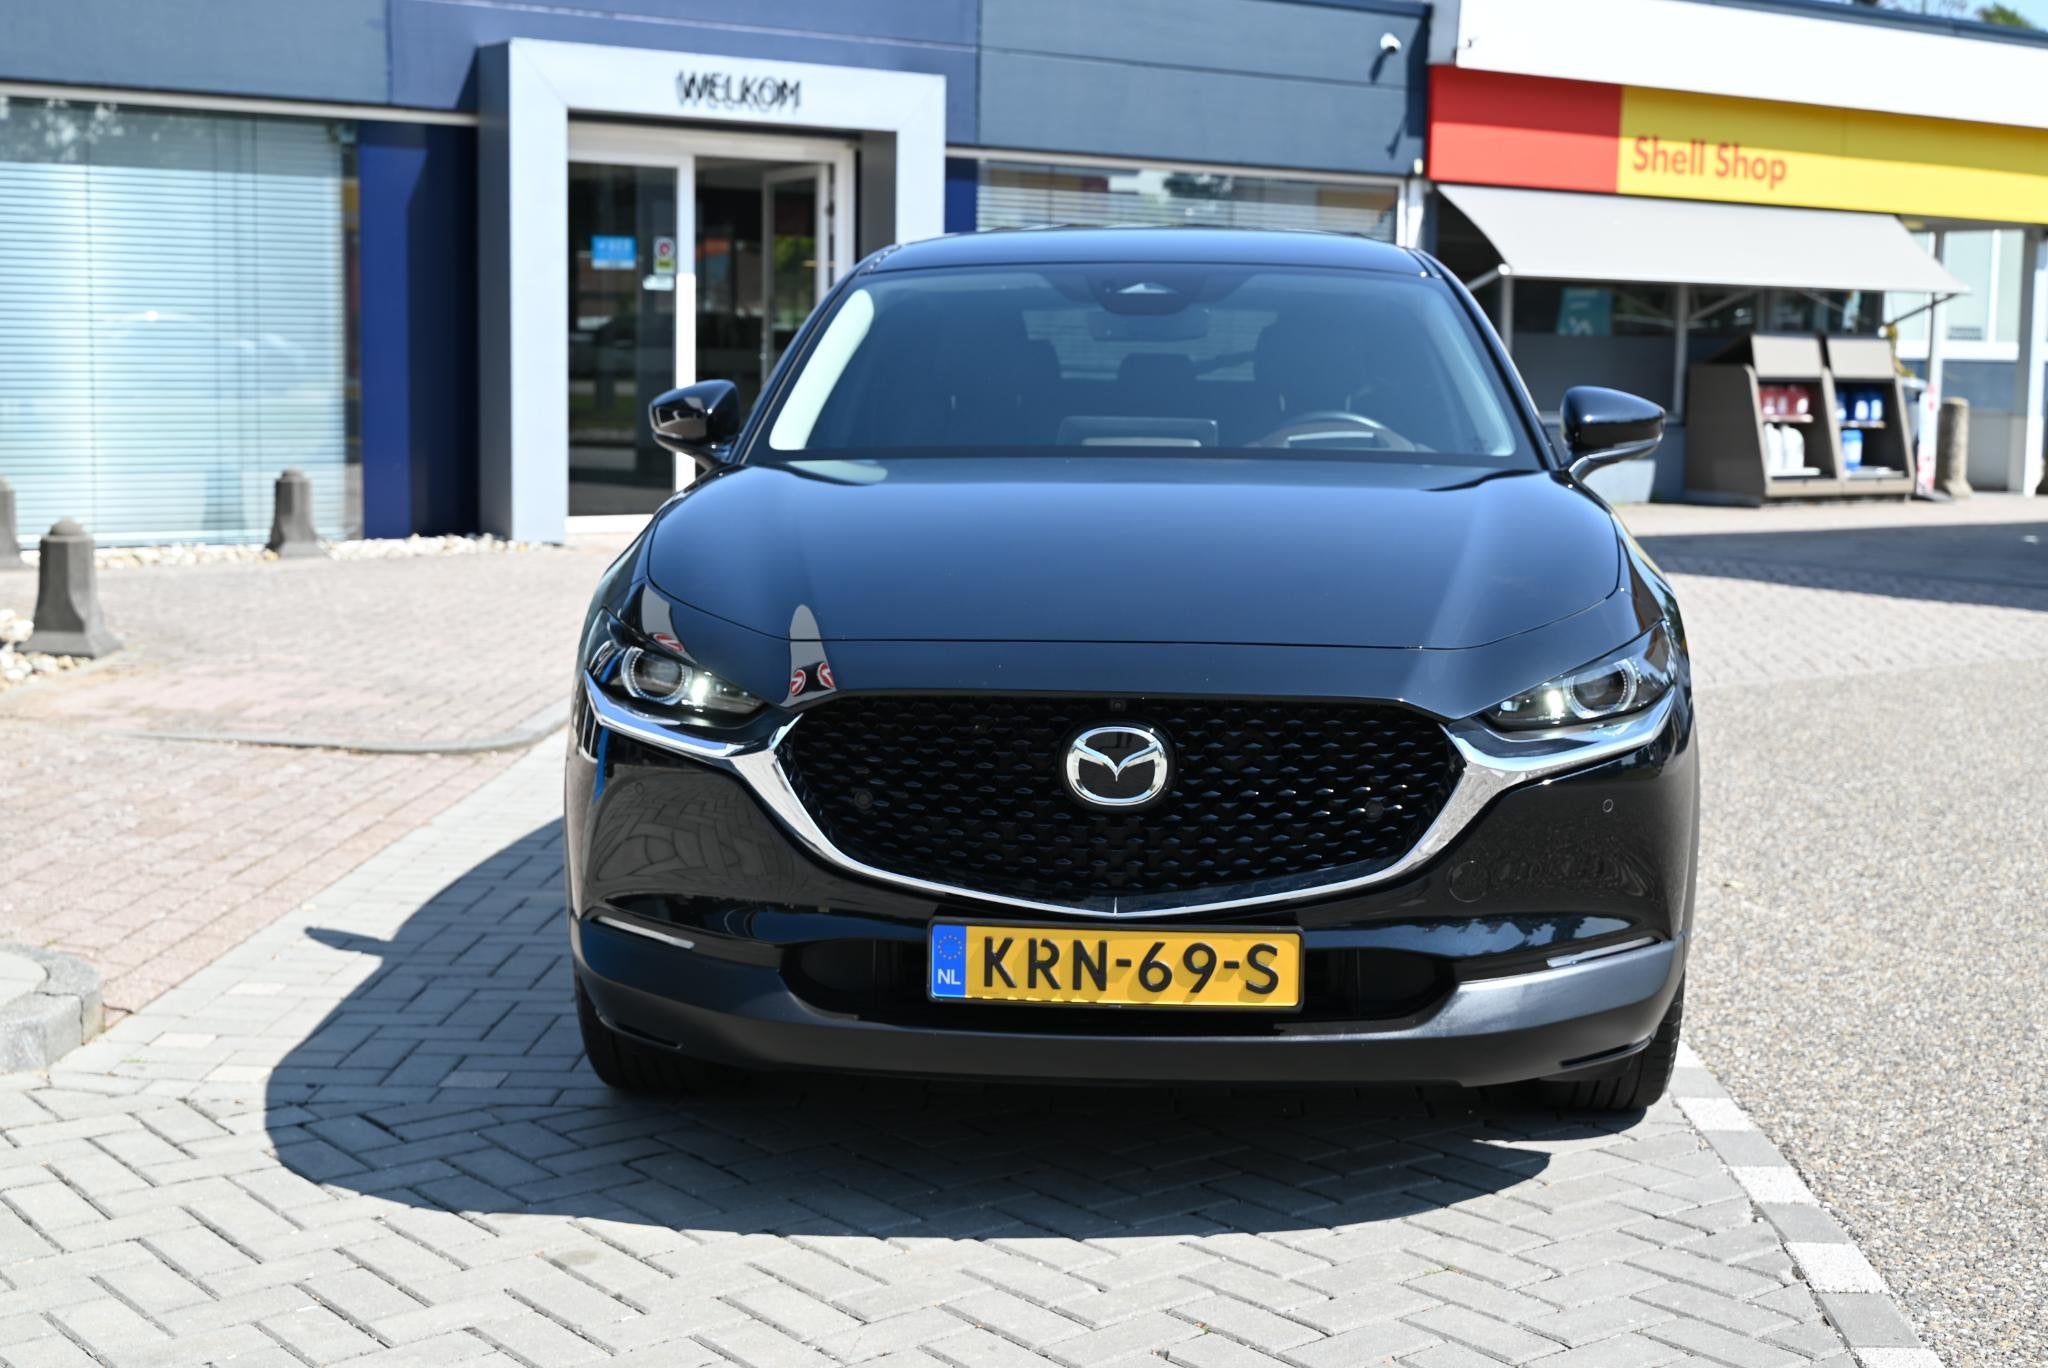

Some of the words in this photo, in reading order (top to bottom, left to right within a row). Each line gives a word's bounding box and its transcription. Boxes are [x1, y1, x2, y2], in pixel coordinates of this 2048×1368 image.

[677, 70, 801, 109] WELKOM
[1633, 135, 1706, 176] Shell
[1715, 142, 1788, 191] Shop
[937, 968, 961, 985] NL
[983, 936, 1280, 995] KRN-69-S
